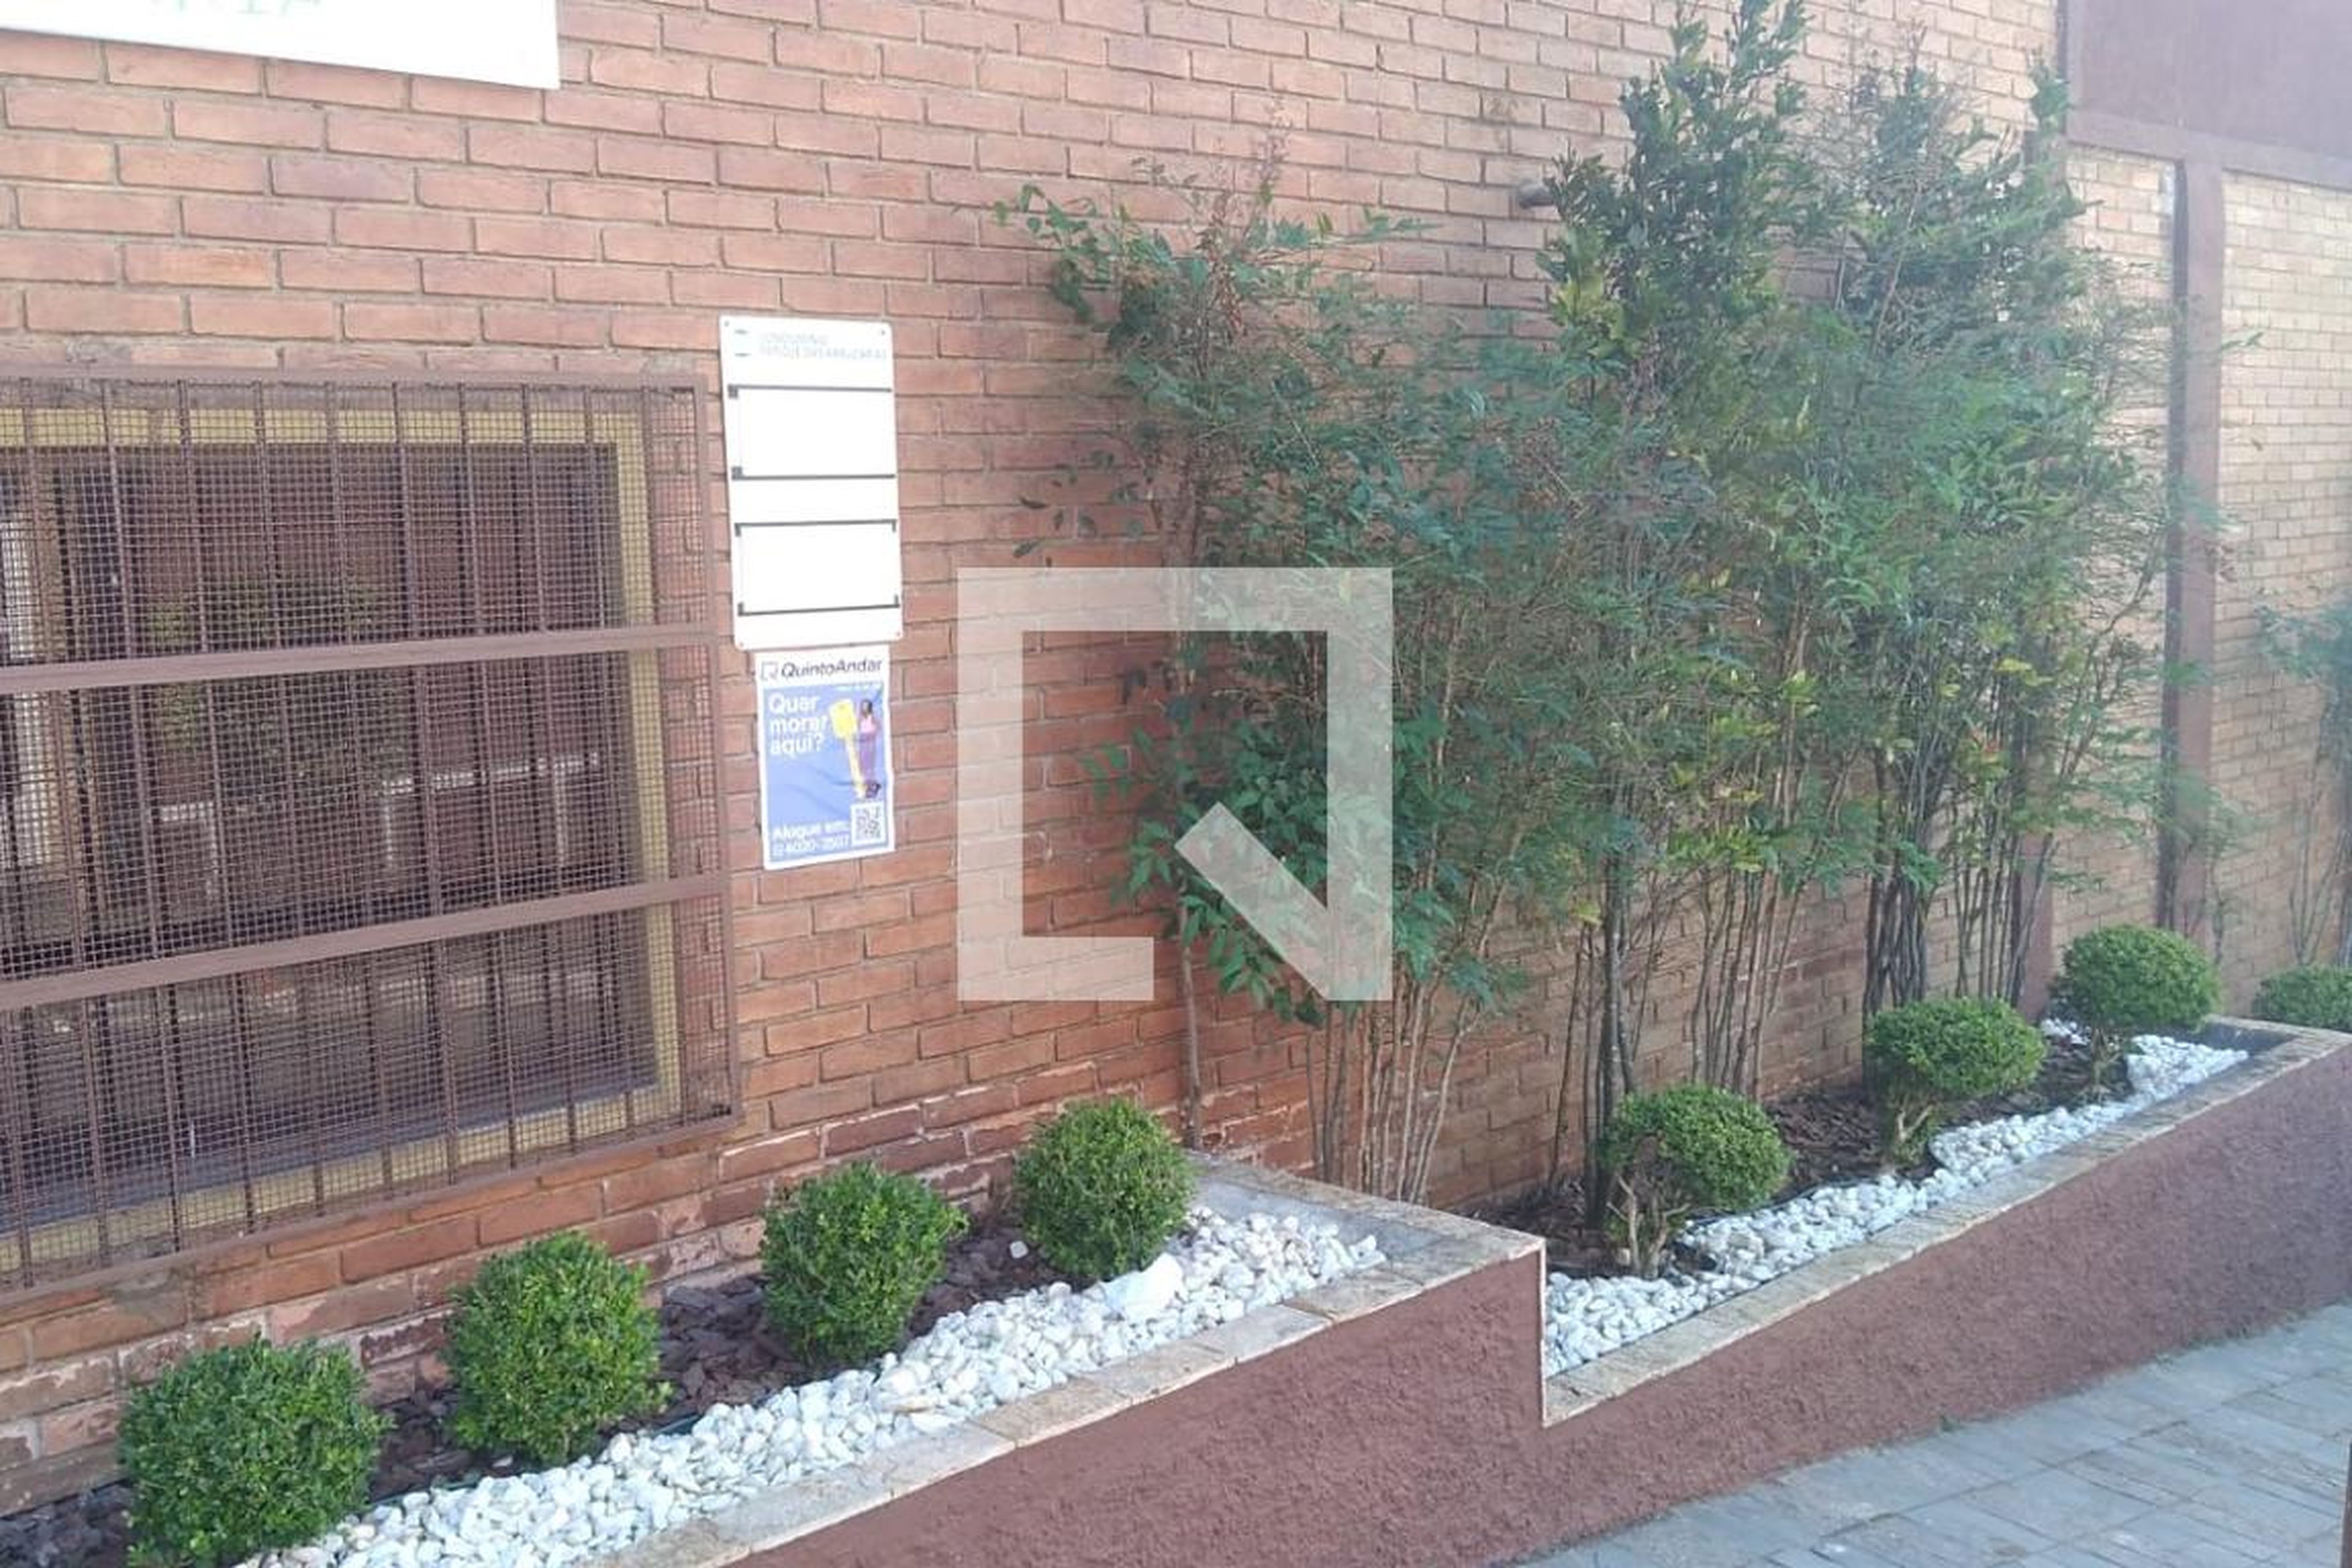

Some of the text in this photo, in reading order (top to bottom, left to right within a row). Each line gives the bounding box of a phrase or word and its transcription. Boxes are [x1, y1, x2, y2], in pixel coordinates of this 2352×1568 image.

[781, 658, 883, 679] QuintoAndar
[768, 694, 821, 714] Quer
[771, 733, 824, 758] aqui?
